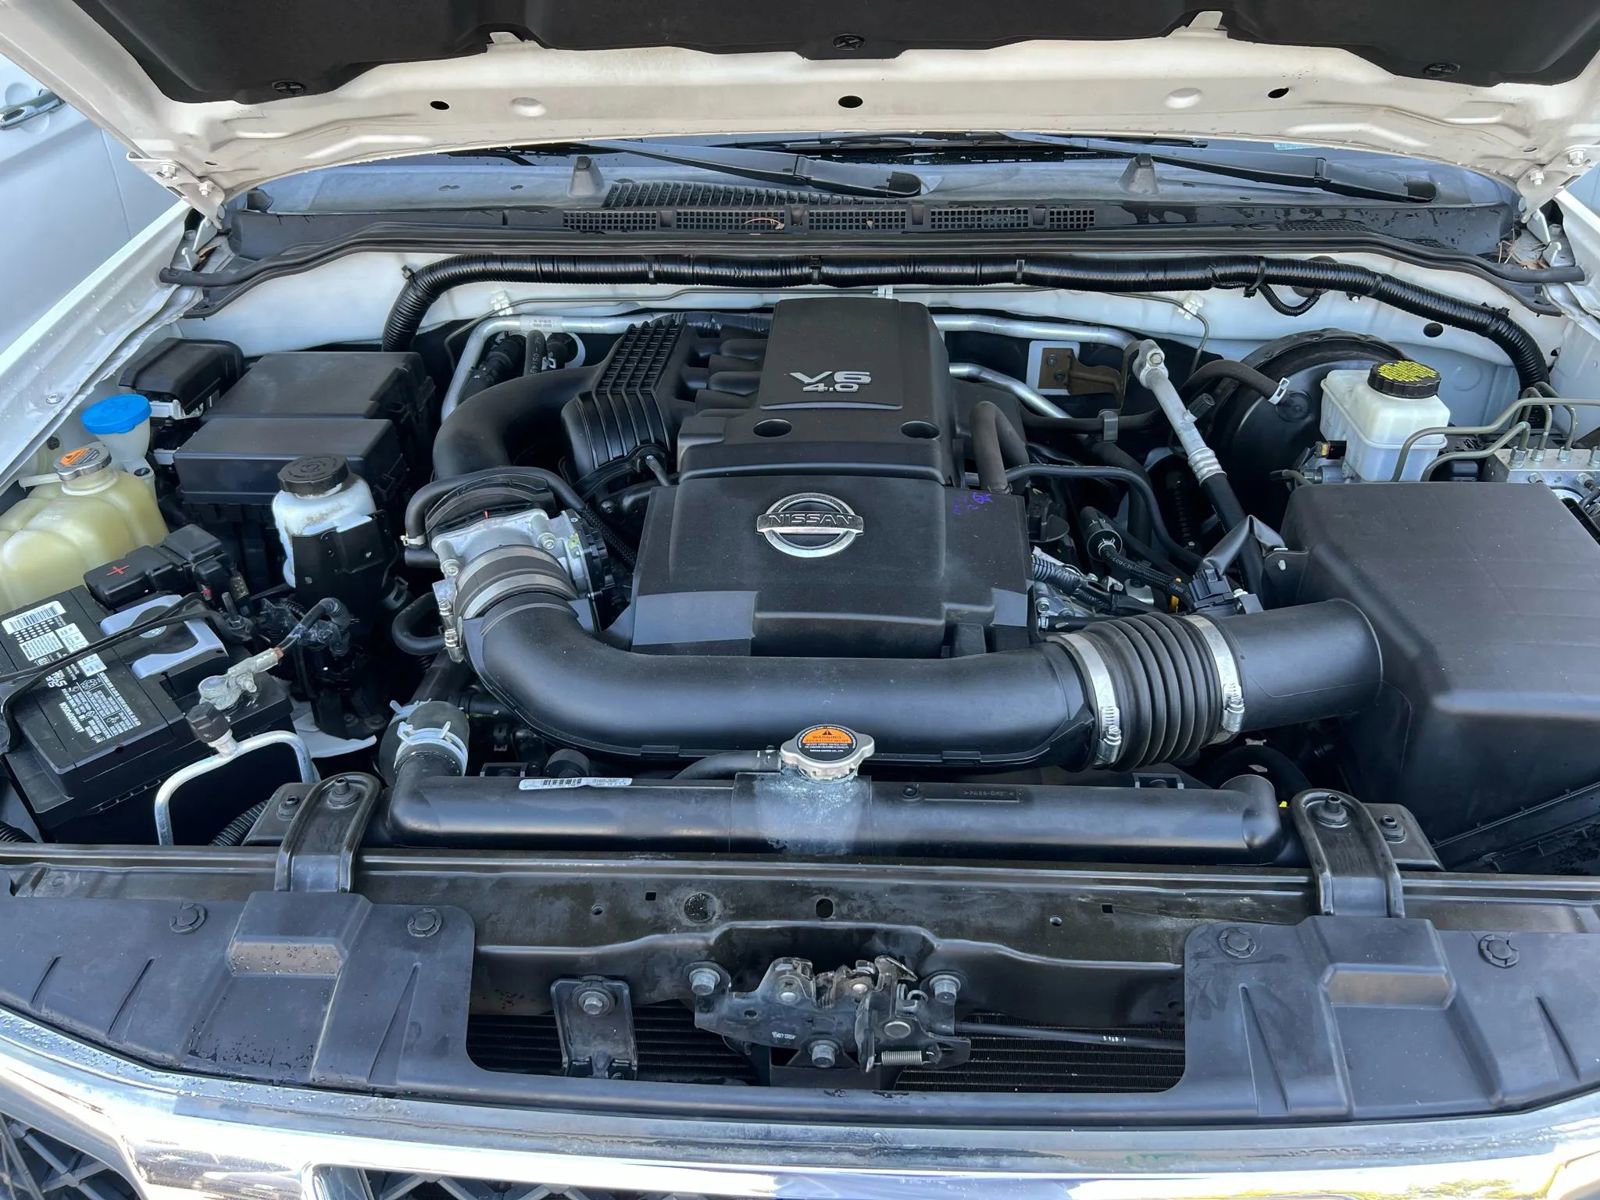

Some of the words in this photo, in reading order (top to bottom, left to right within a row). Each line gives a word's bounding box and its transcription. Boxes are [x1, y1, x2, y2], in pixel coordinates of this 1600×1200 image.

[789, 371, 872, 385] V6
[802, 383, 860, 393] 4.0
[768, 513, 853, 526] NISSAN
